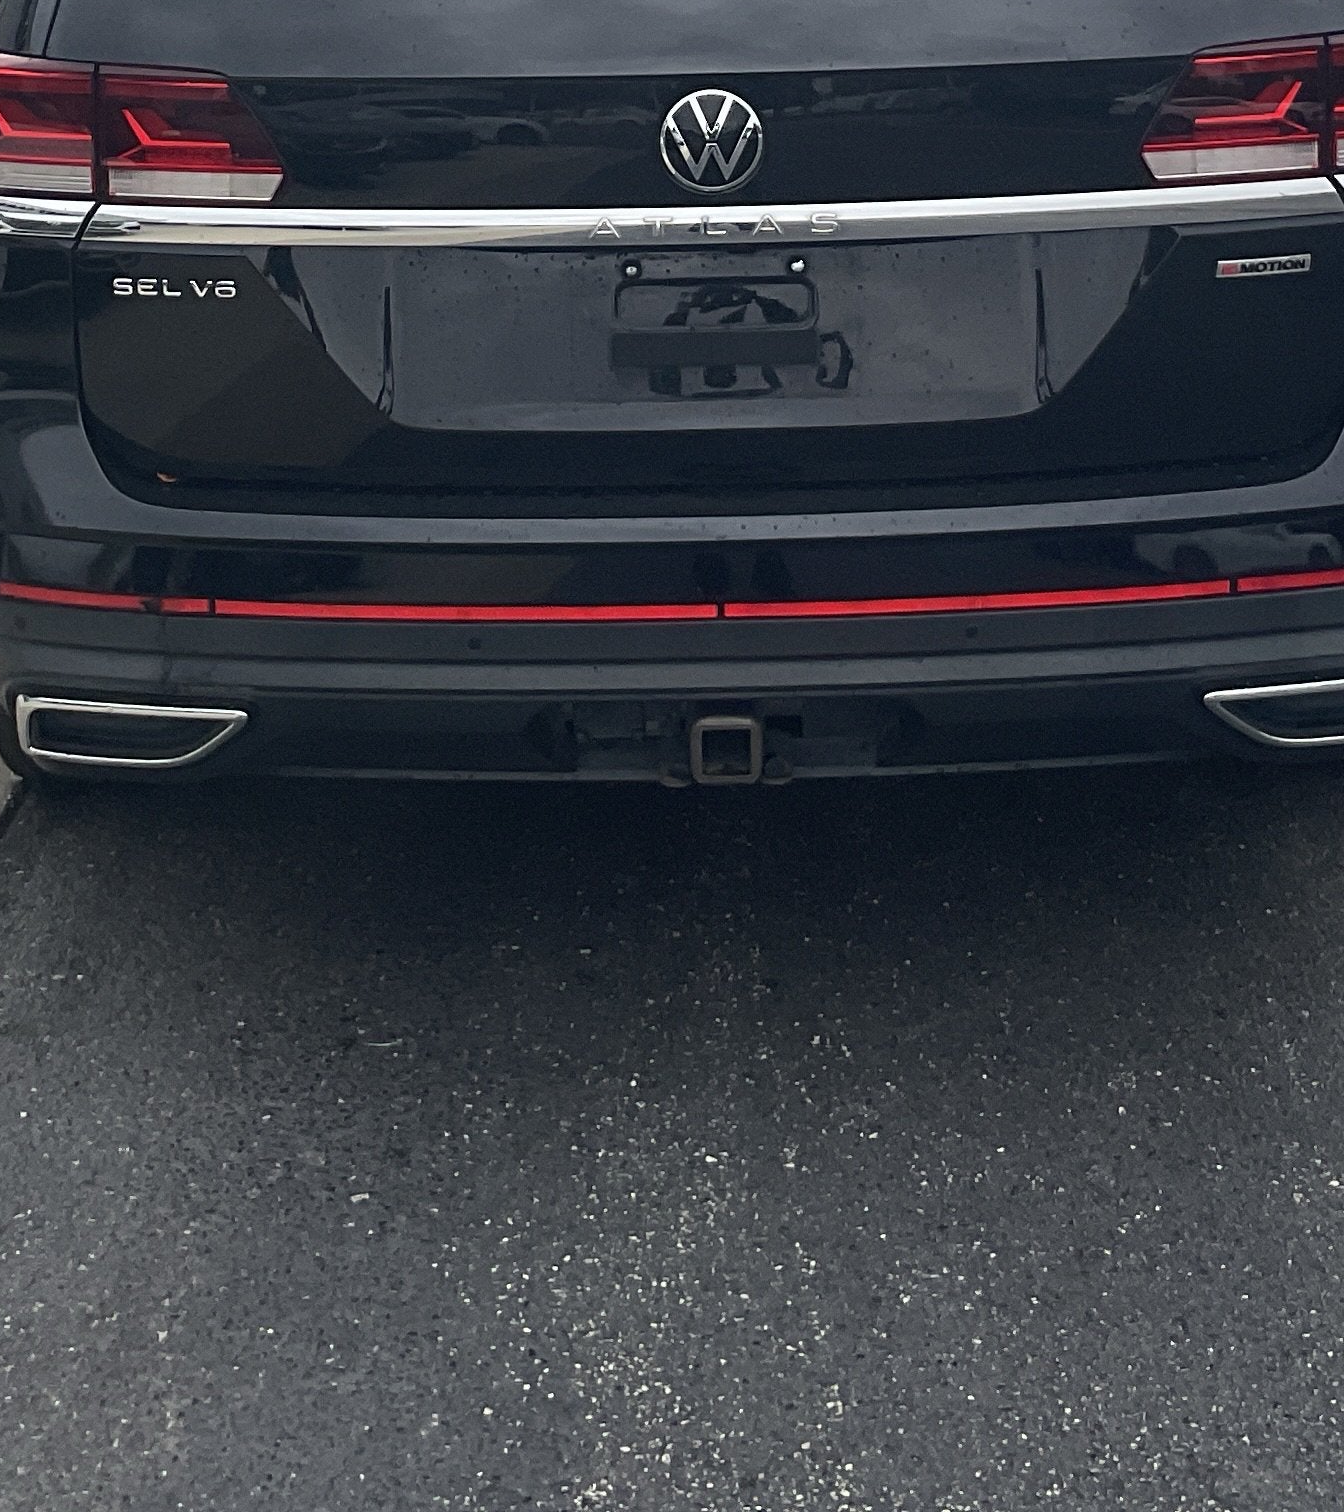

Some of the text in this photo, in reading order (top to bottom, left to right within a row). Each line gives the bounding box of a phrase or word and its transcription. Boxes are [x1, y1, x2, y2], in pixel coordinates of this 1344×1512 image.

[590, 213, 839, 239] ATLAS
[113, 277, 236, 298] SEL V6
